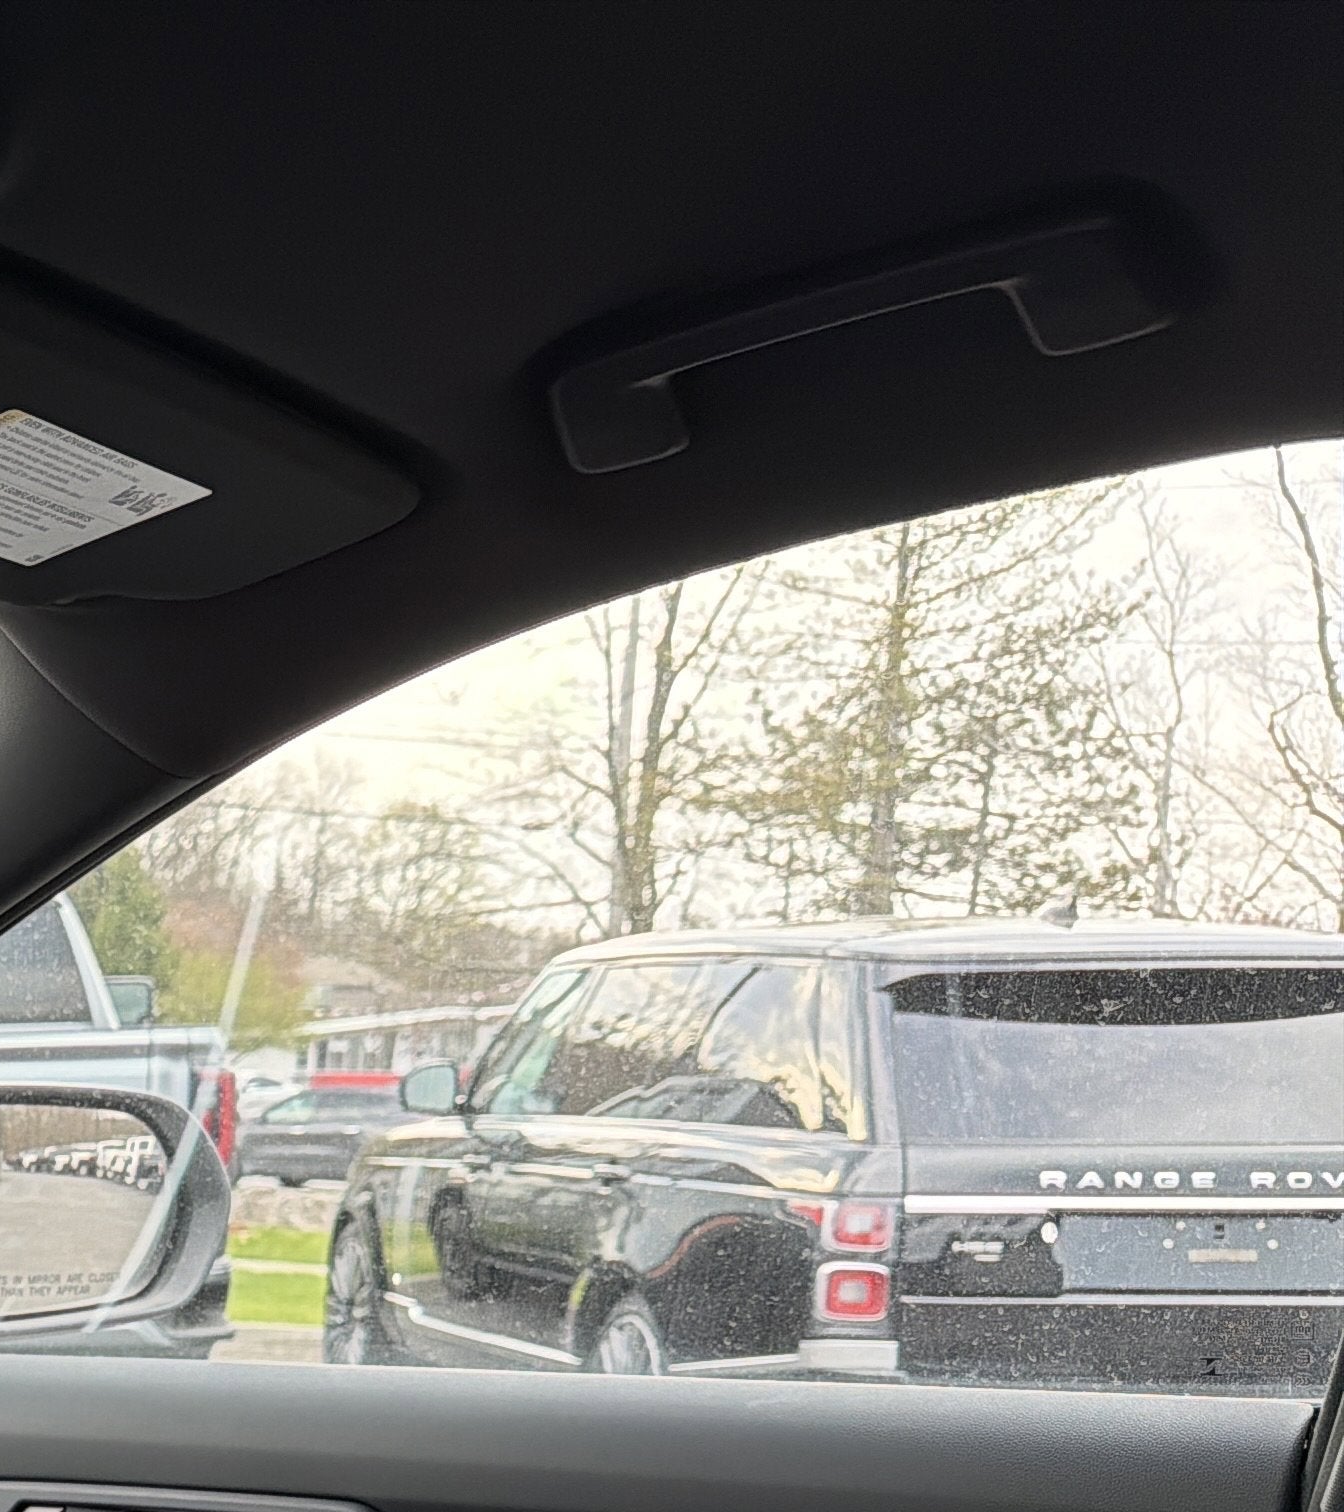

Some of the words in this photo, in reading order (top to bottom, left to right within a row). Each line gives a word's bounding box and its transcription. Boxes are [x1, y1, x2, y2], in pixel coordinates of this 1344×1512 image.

[1038, 1170, 1217, 1190] RANGE
[12, 1275, 23, 1285] IN
[27, 1273, 61, 1285] MIRROR
[66, 1272, 86, 1284] ARE
[0, 1286, 24, 1297] THAN
[29, 1286, 52, 1297] THEY
[56, 1284, 91, 1296] APPEAR
